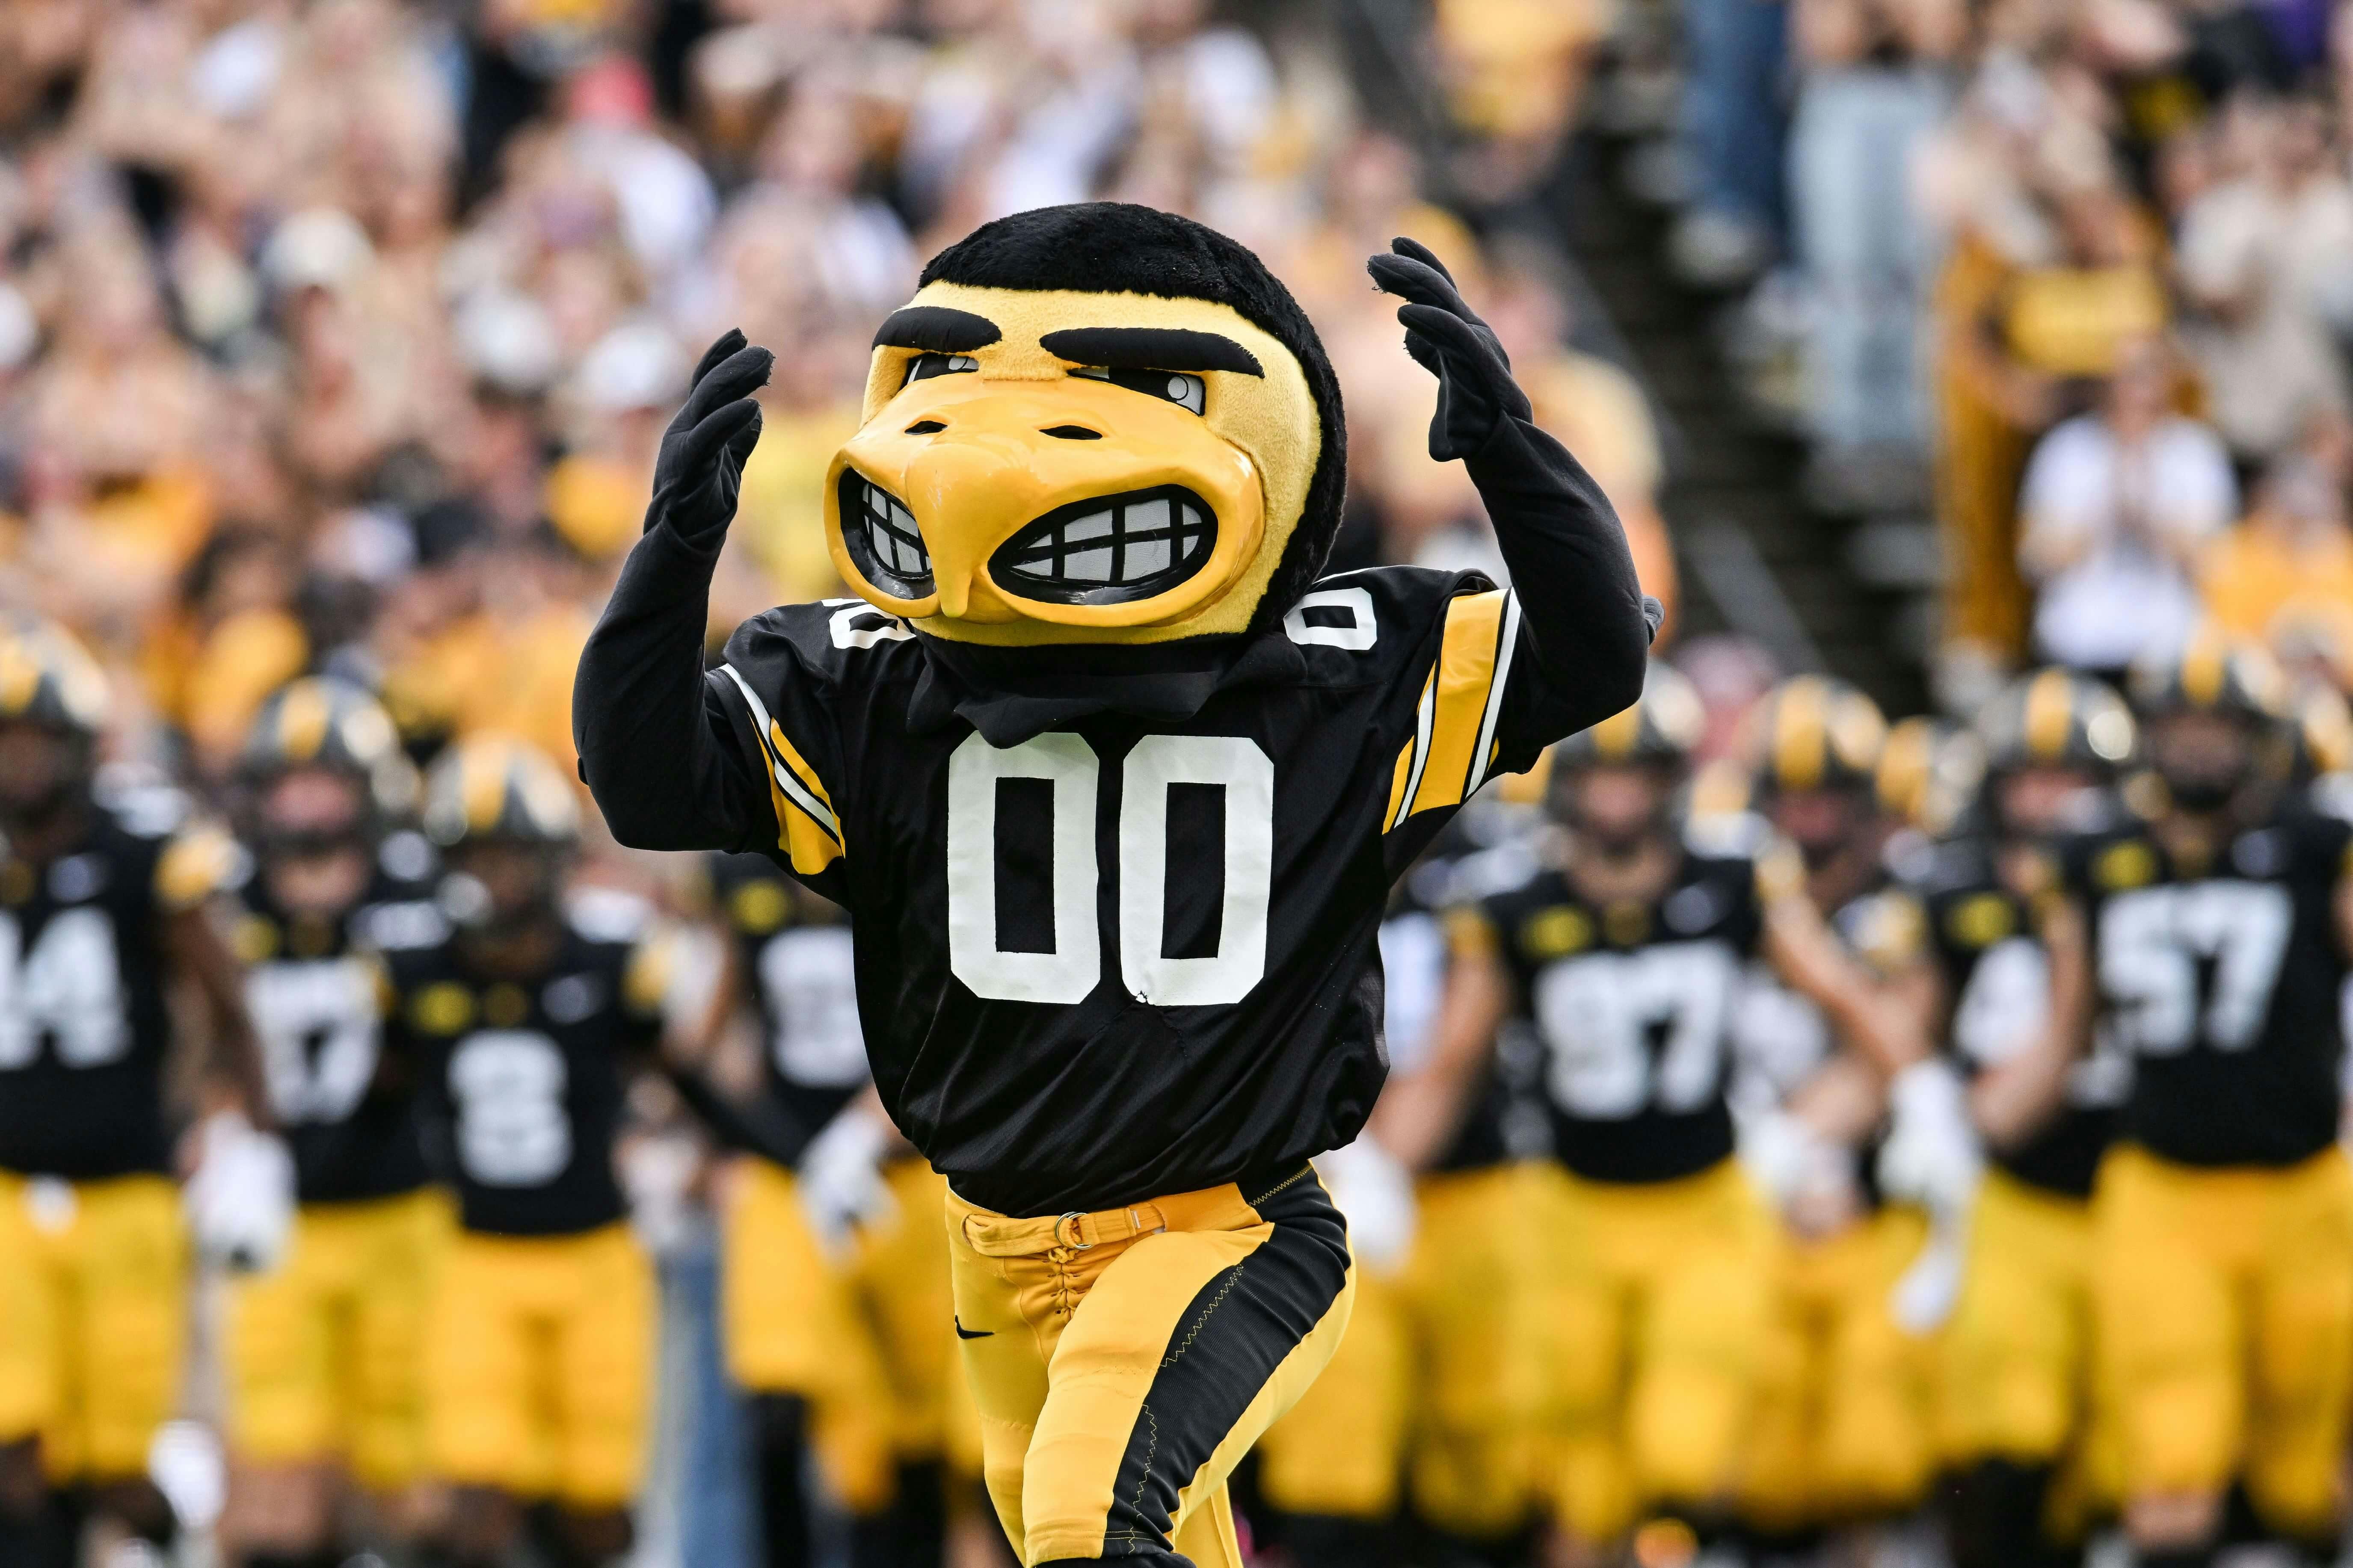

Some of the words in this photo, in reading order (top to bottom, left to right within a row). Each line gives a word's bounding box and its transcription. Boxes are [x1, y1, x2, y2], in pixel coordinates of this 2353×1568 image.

[947, 730, 1274, 1006] 00
[0, 907, 130, 1069] 4
[2097, 880, 2294, 1056] 57
